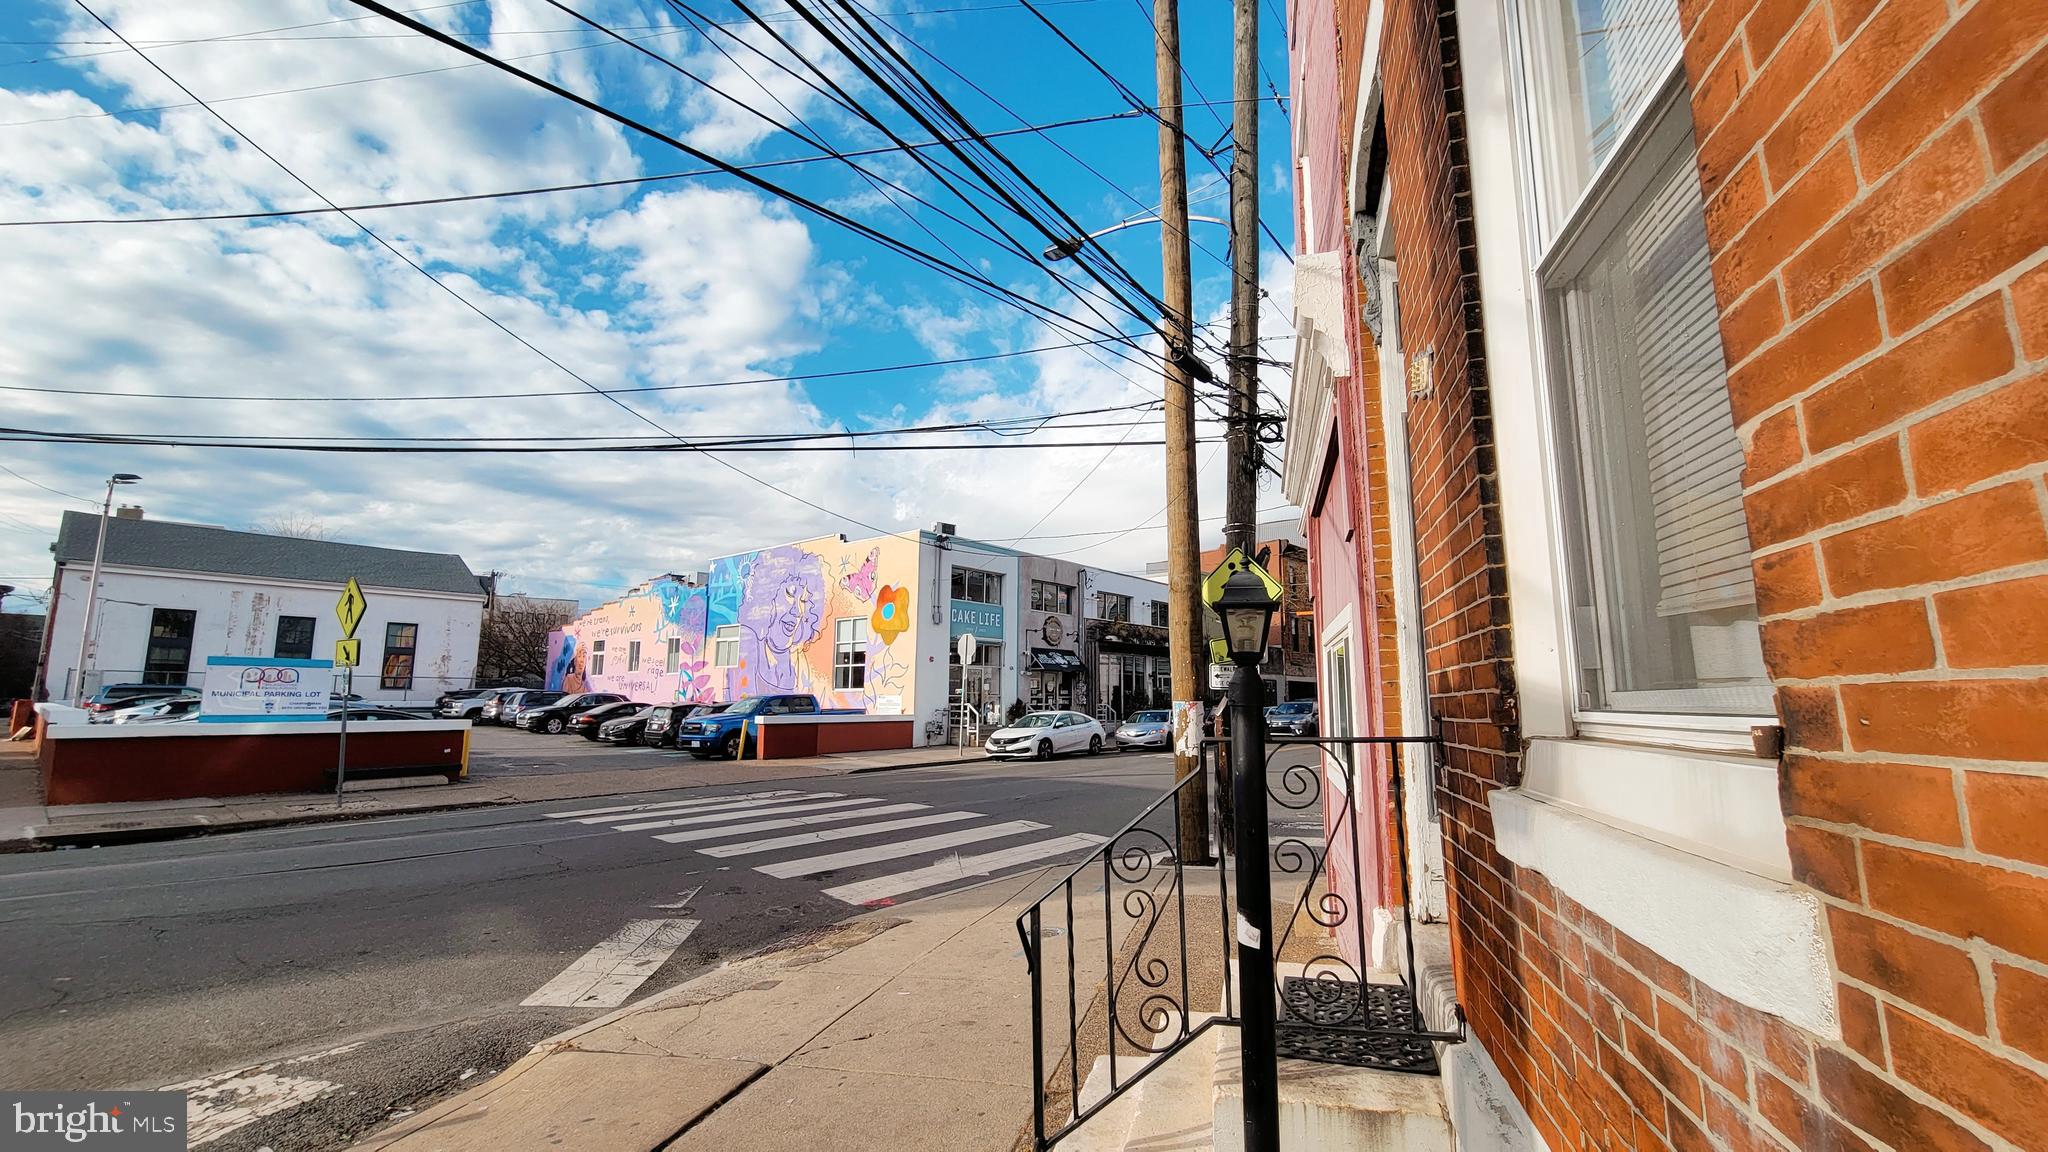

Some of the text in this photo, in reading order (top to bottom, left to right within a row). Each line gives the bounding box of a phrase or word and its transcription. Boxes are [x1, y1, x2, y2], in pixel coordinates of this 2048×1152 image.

[951, 608, 1001, 627] CAKE LIFE
[647, 667, 665, 679] rage
